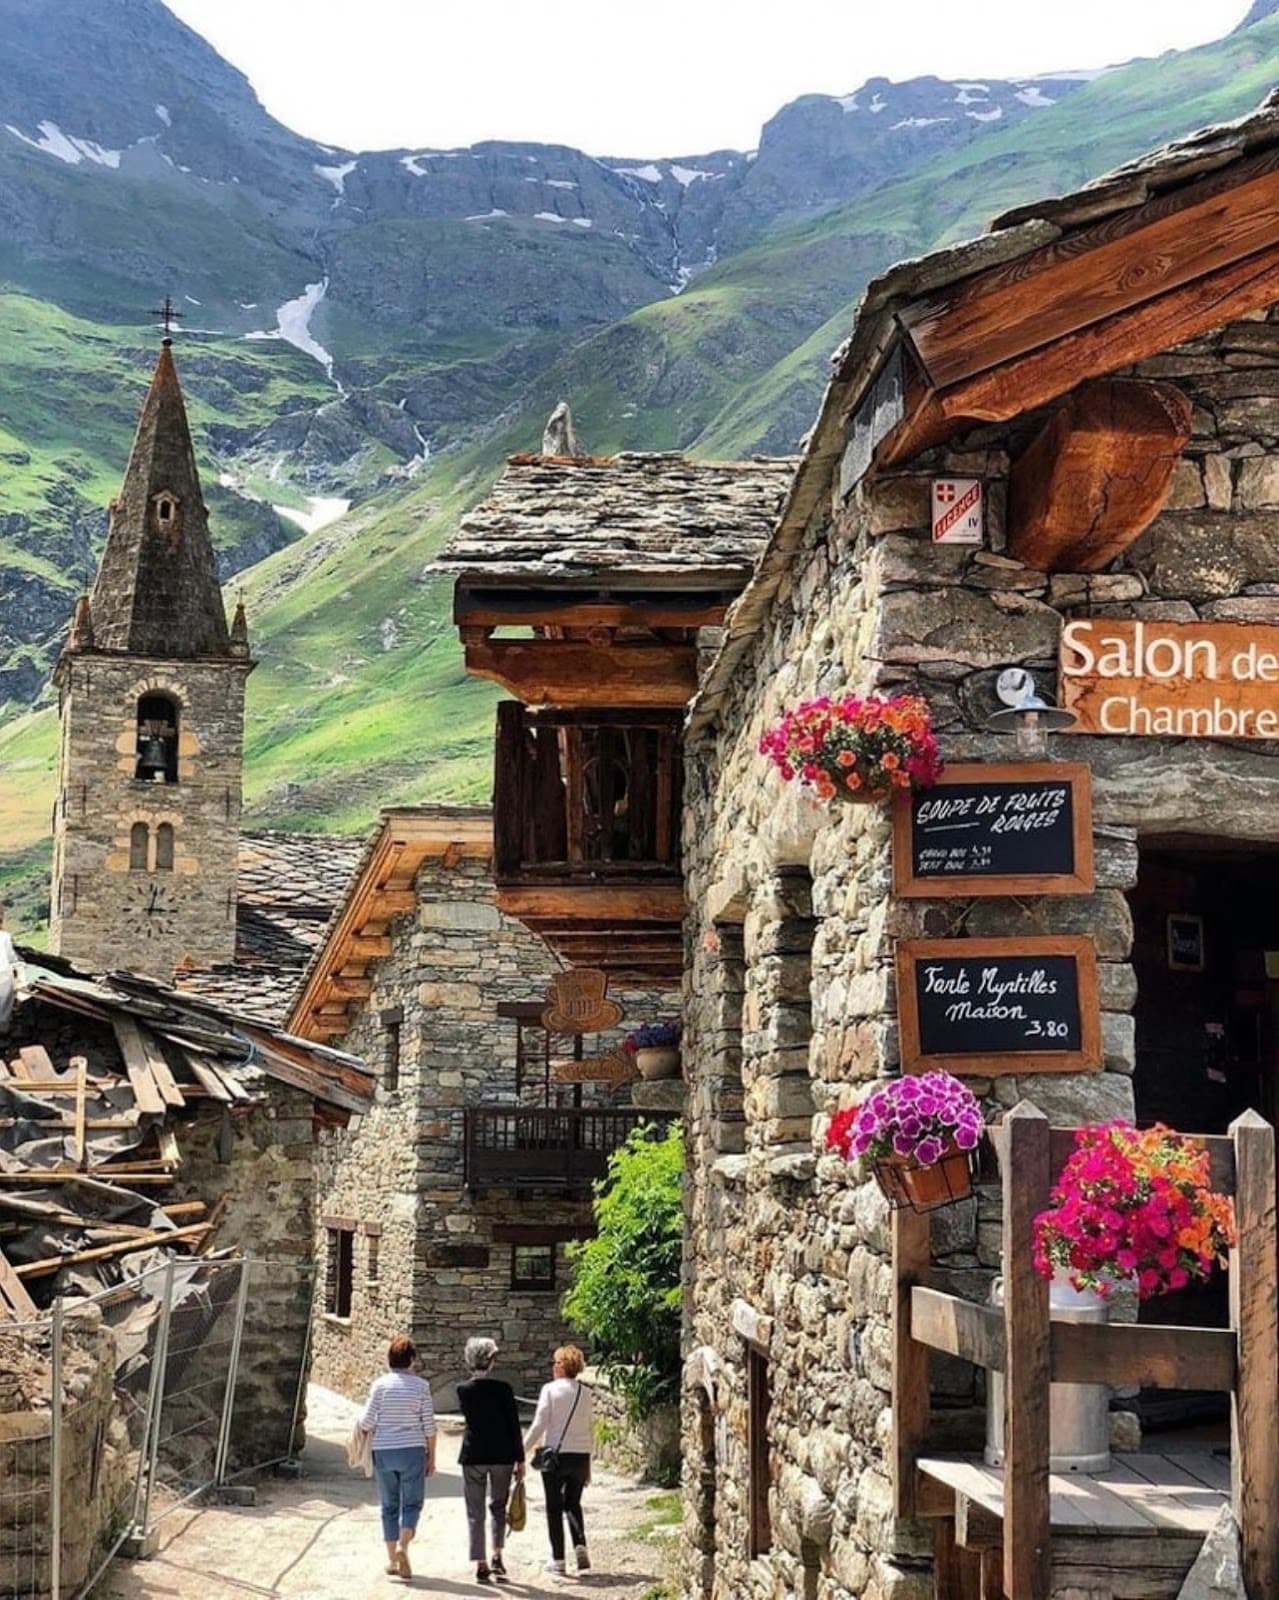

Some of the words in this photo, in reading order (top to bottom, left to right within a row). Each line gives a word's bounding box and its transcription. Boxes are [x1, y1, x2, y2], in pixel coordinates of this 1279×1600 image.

[968, 518, 978, 528] IV
[1062, 621, 1217, 681] Salon
[1231, 642, 1279, 681] de
[1100, 696, 1279, 737] Chambre
[917, 798, 977, 825] SOUPE
[975, 795, 1001, 815] DE
[1003, 789, 1067, 812] FRUITS
[990, 809, 1060, 833] ROUGES
[924, 966, 970, 994] Tarte
[977, 967, 1058, 1005] Myrtilles
[945, 1001, 1028, 1022] Maison
